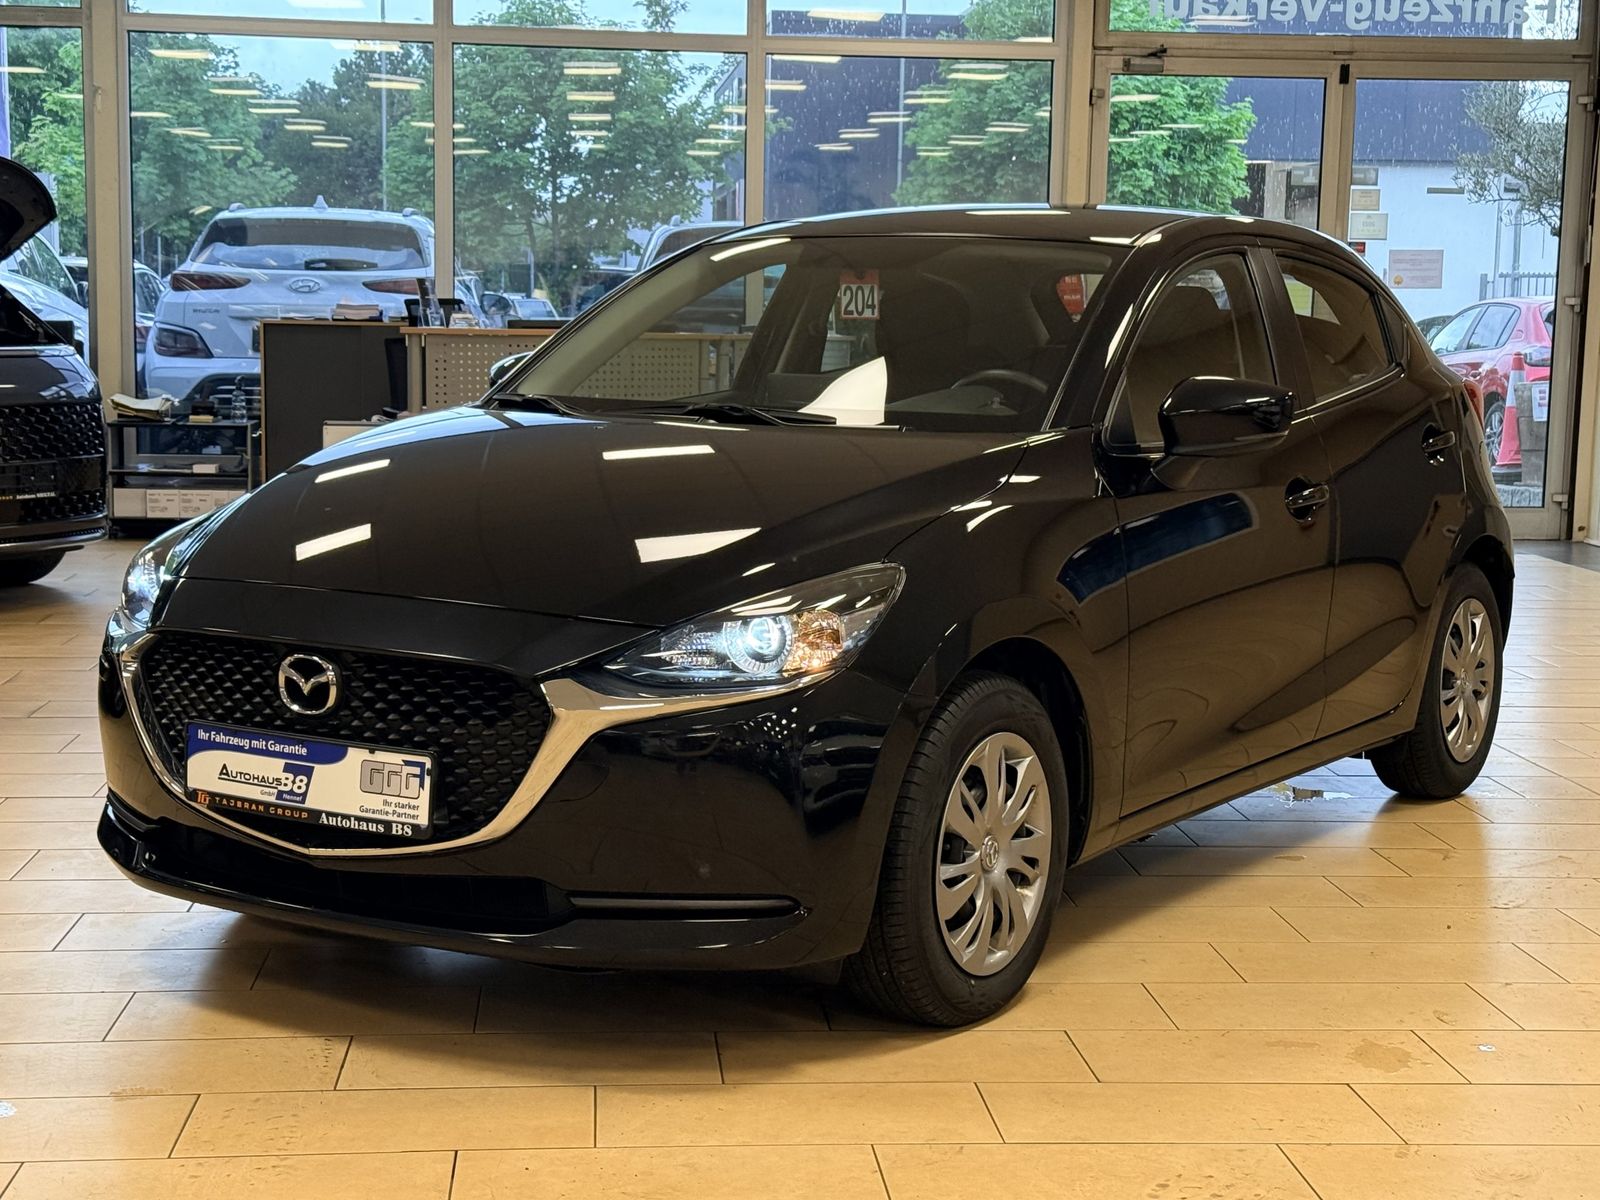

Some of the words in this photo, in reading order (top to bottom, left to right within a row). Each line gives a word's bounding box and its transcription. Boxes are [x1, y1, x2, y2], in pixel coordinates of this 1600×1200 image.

[843, 285, 876, 316] 204
[197, 729, 210, 740] Ihr
[211, 731, 250, 750] Fahrzeug
[251, 739, 266, 750] mit
[267, 740, 308, 756] Garantie
[260, 789, 276, 797] GmbH
[282, 793, 303, 801] Hennef
[215, 796, 264, 812] TAJBRAN
[269, 807, 309, 819] GROUP
[359, 805, 420, 820] Garantie-Partner
[382, 799, 393, 807] Ihr
[394, 801, 420, 811] starker
[319, 812, 385, 833] Autohaus
[391, 822, 412, 837] B8
